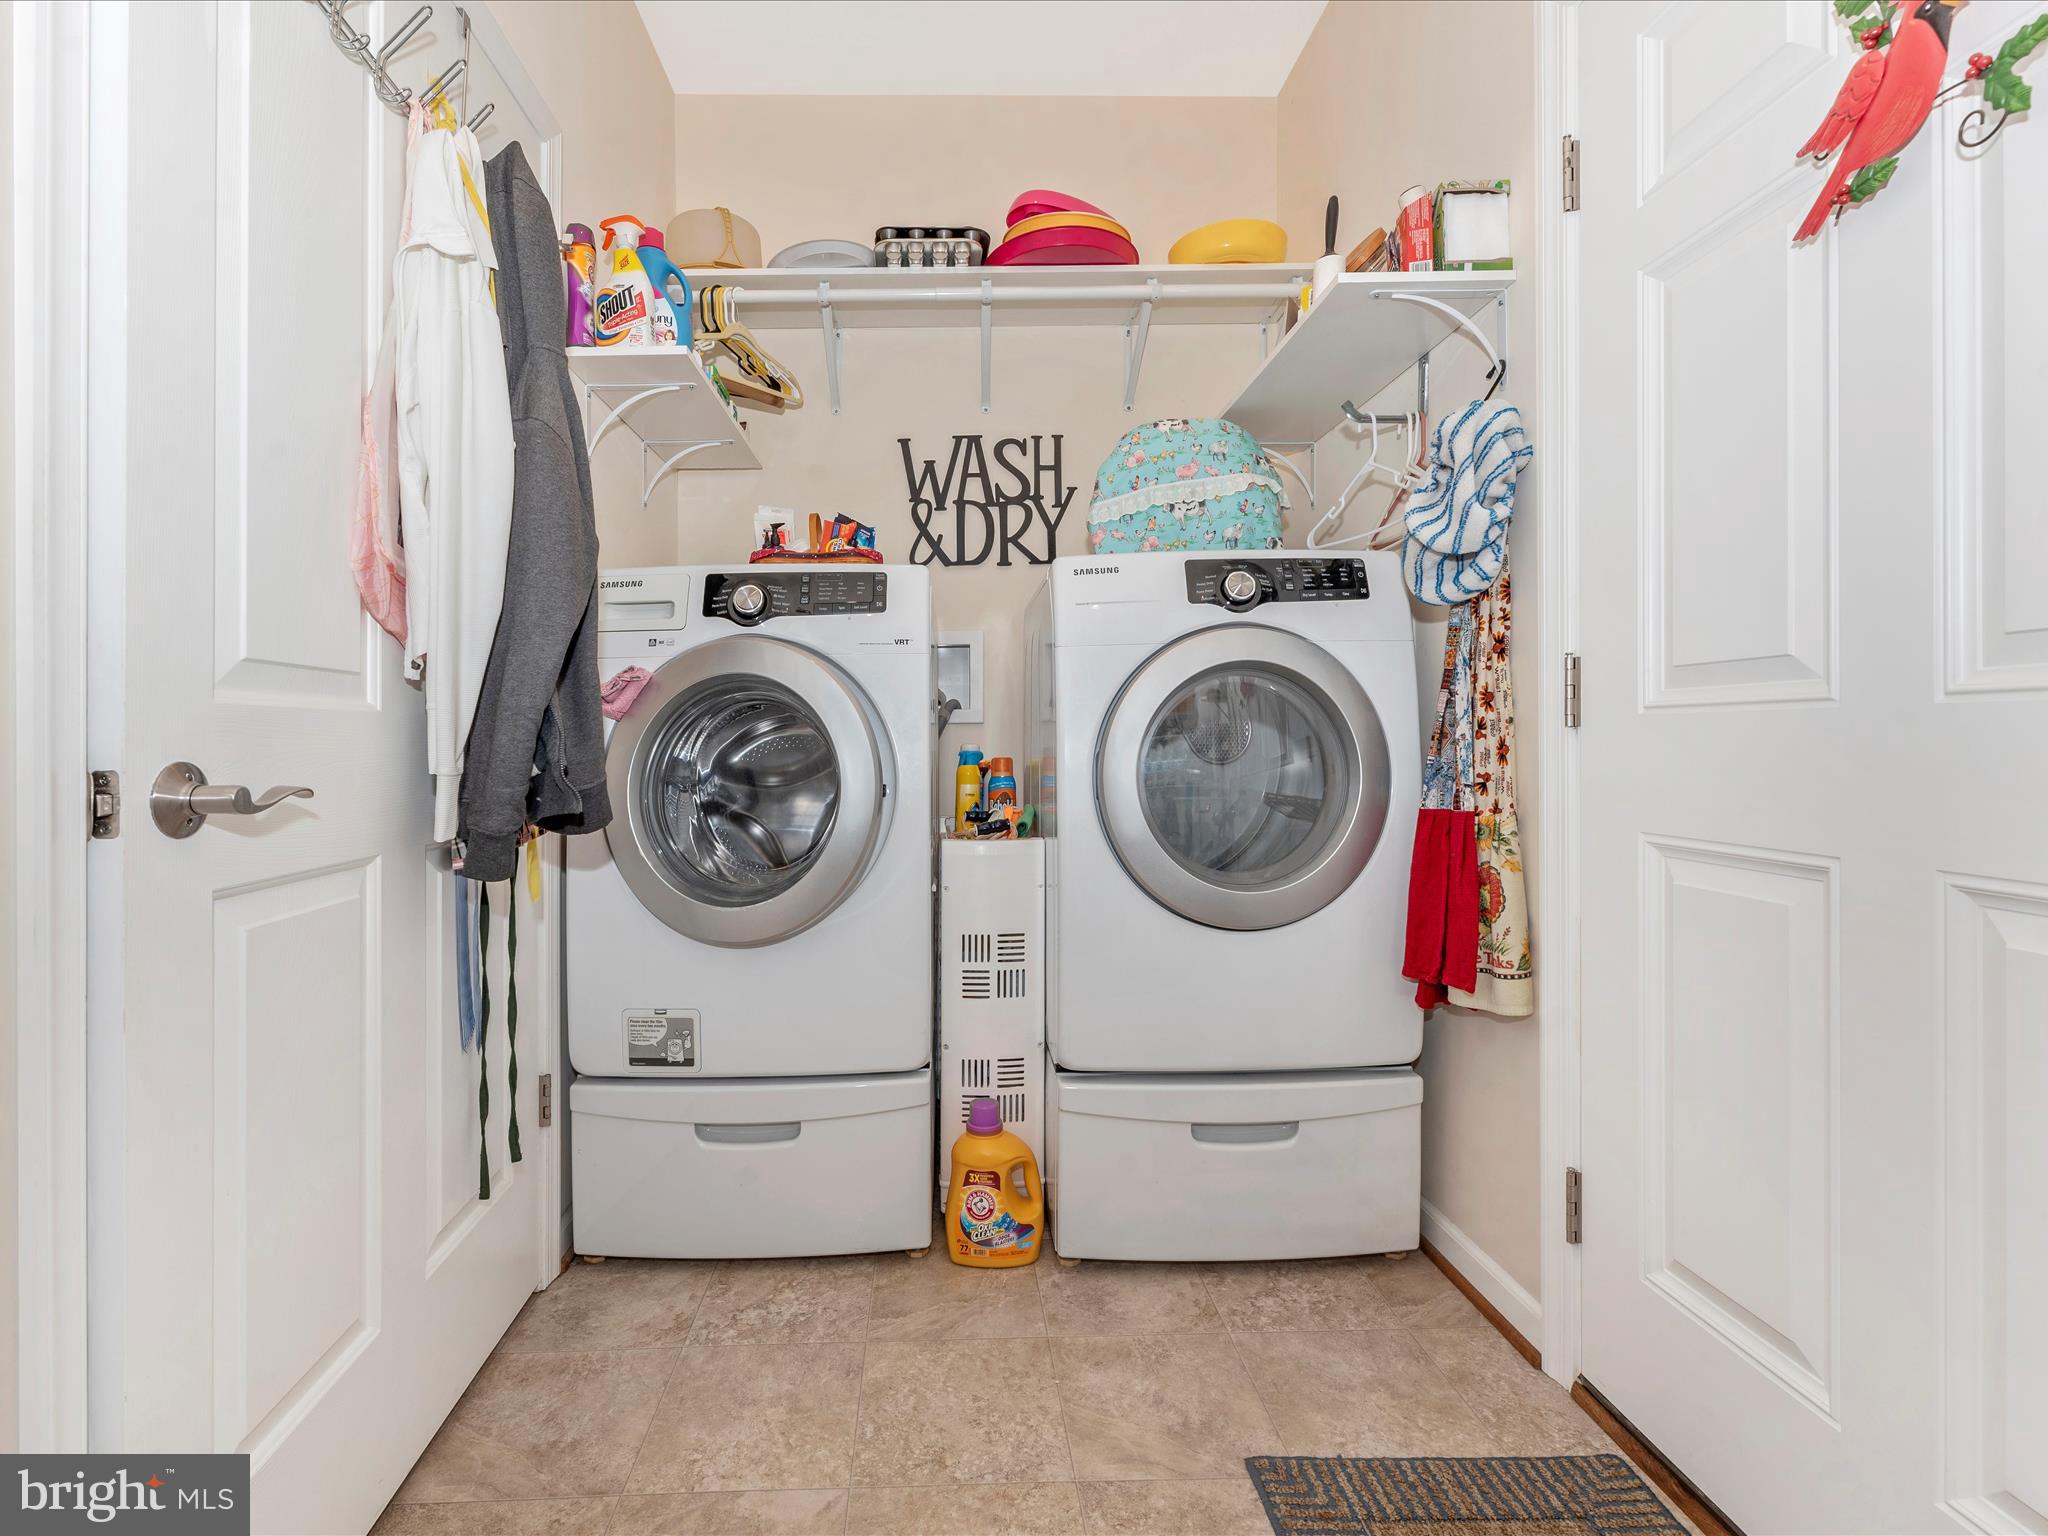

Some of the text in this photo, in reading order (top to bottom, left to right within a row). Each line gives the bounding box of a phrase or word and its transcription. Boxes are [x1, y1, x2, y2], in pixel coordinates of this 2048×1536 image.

[600, 285, 634, 324] SHOUT
[897, 435, 1064, 511] WASH
[952, 487, 1078, 566] DRY
[1073, 566, 1120, 576] SAMSUNG
[600, 580, 643, 589] SAMSUNG
[894, 638, 910, 646] VRT
[968, 1173, 980, 1184] 3X
[978, 1223, 992, 1231] OXI
[973, 1228, 997, 1240] CLEAN
[960, 1244, 969, 1252] 77
